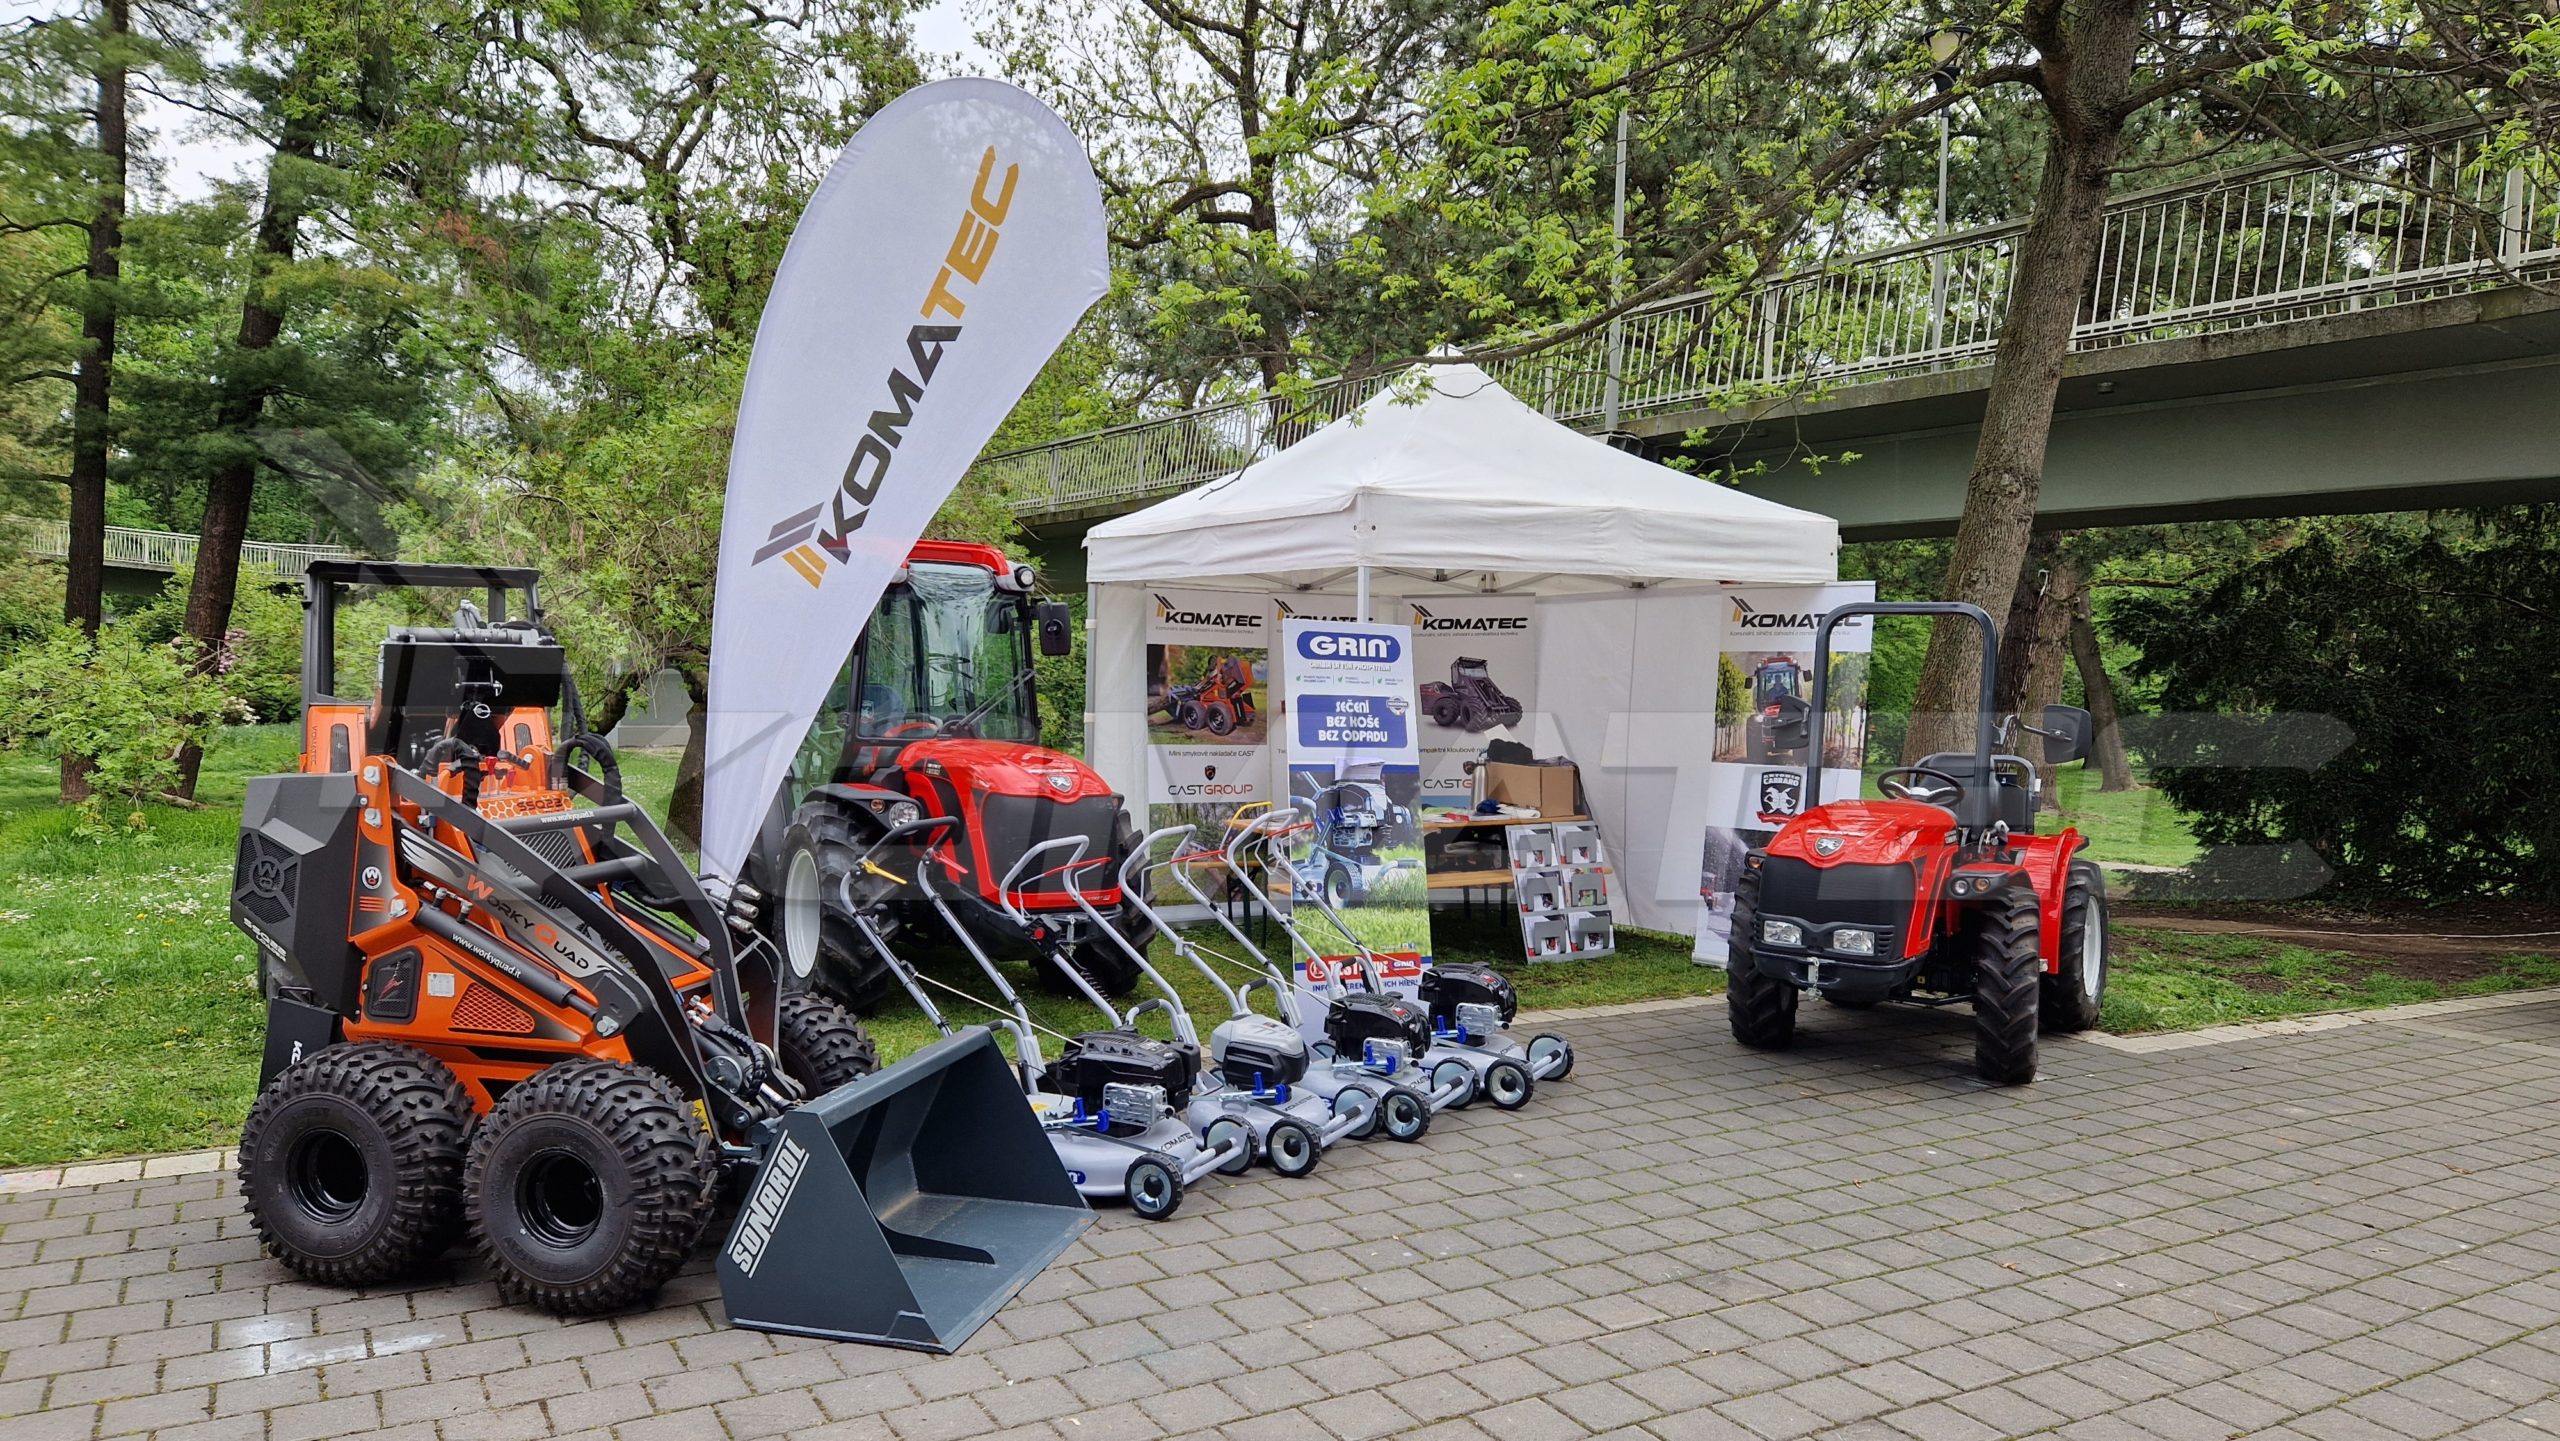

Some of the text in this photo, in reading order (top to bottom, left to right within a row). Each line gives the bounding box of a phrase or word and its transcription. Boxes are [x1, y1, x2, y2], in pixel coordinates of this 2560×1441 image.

[817, 145, 1019, 565] KOMATEC
[1165, 611, 1262, 627] KOMATEC
[1422, 617, 1528, 631] KOMATEC
[1740, 613, 1864, 629] KOMATC
[1326, 716, 1347, 728] BEZ
[1318, 729, 1388, 742] BEZ ODPADU
[1168, 784, 1253, 795] CASTGROUP
[1423, 778, 1473, 789] CASTG
[452, 933, 522, 979] www.workyquad.it
[731, 1137, 806, 1273] SONAROL
